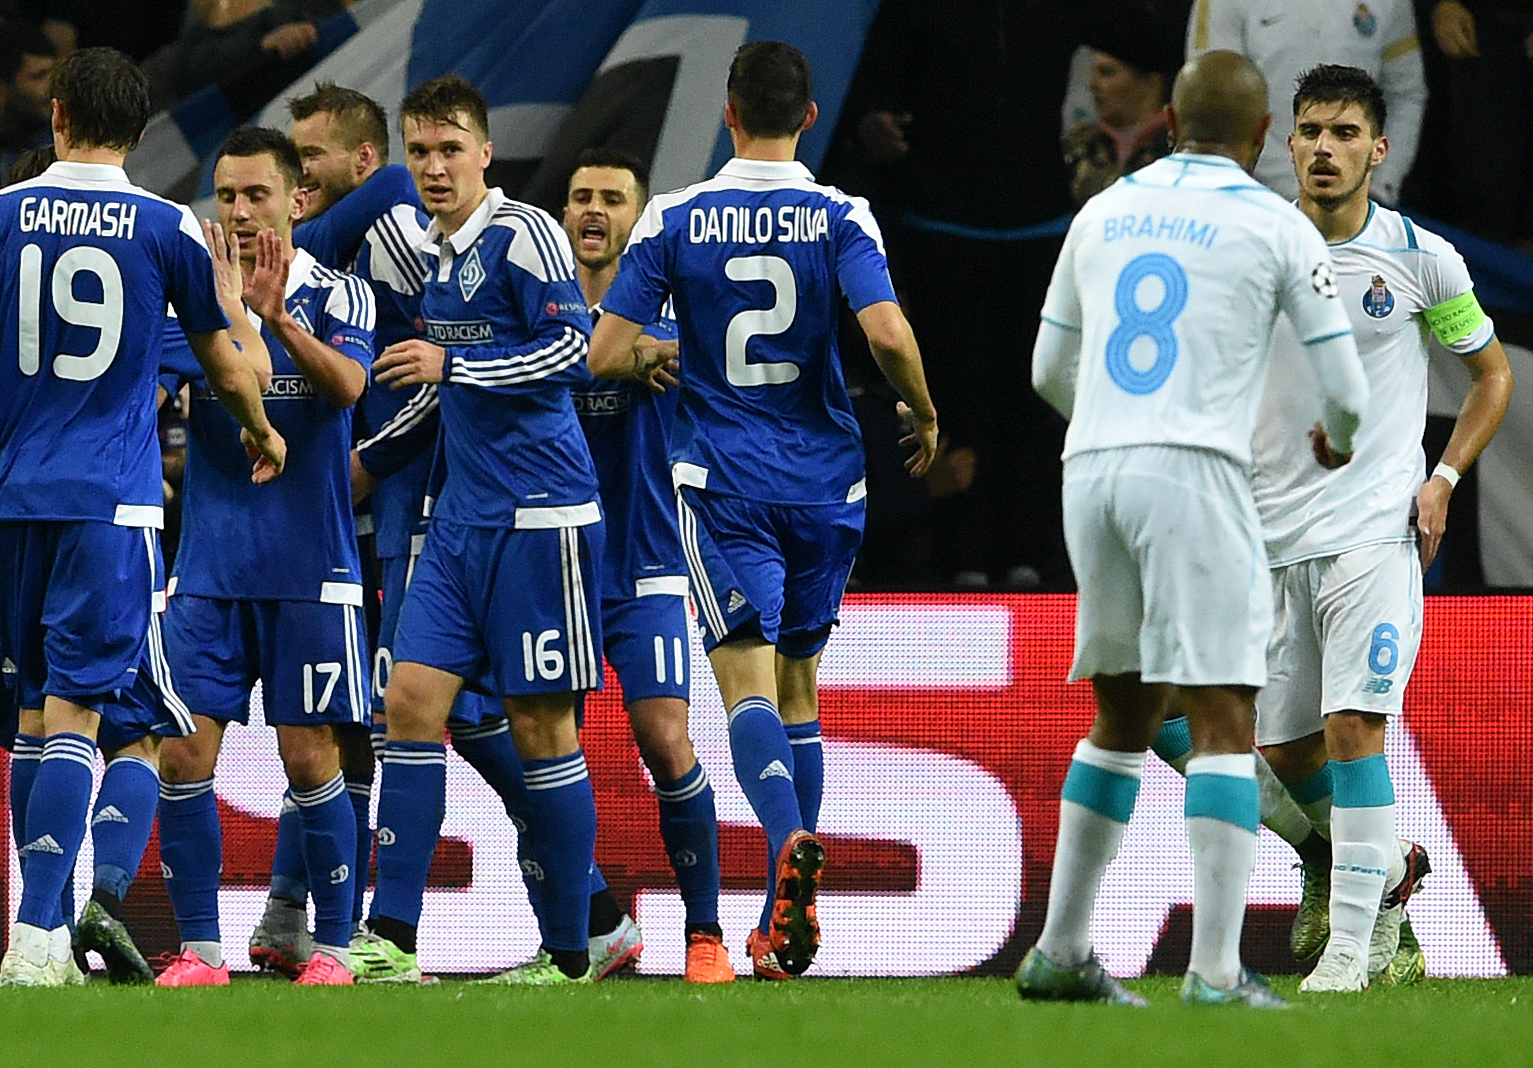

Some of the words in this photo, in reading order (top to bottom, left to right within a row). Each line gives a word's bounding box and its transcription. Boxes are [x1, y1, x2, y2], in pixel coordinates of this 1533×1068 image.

[20, 196, 137, 240] GARMASH
[689, 206, 773, 244] DANILO
[777, 205, 829, 243] SILVA
[1104, 214, 1219, 250] BRAHIMI
[19, 243, 124, 382] 19
[446, 324, 494, 340] RACISM
[725, 255, 800, 387] 2
[1105, 252, 1189, 396] 8
[262, 379, 314, 396] ACISM
[588, 396, 629, 411] RACIS
[372, 647, 393, 699] 0
[522, 629, 565, 682] 16
[654, 635, 683, 685] 11
[1369, 622, 1400, 675] 6
[303, 662, 342, 714] 17
